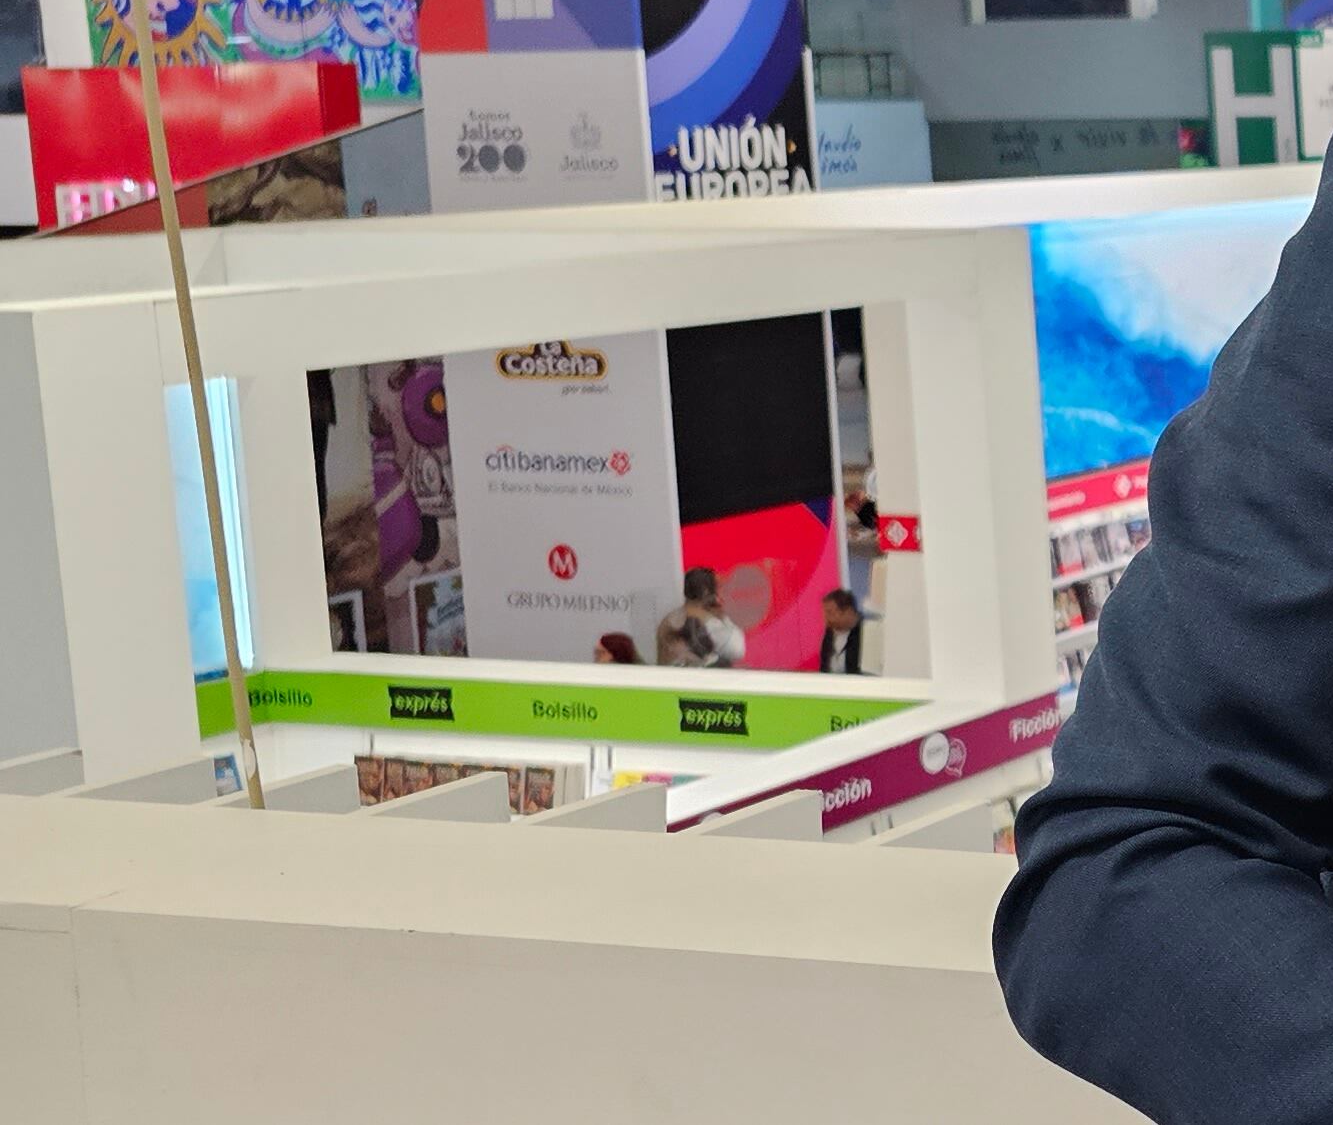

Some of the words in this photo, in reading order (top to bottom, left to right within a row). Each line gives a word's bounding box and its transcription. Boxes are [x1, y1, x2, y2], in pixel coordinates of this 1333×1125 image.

[1212, 44, 1299, 169] H
[457, 122, 524, 142] Jalisco
[678, 114, 788, 172] UNIÓN
[456, 144, 526, 173] 200
[653, 166, 814, 203] EUROPEA
[486, 445, 608, 473] citibanamex
[552, 550, 574, 574] M
[507, 592, 560, 607] GRUPO
[249, 688, 313, 708] Bolsillo
[394, 690, 448, 716] exprés
[532, 700, 598, 722] Bolsillo
[685, 706, 743, 730] exprés
